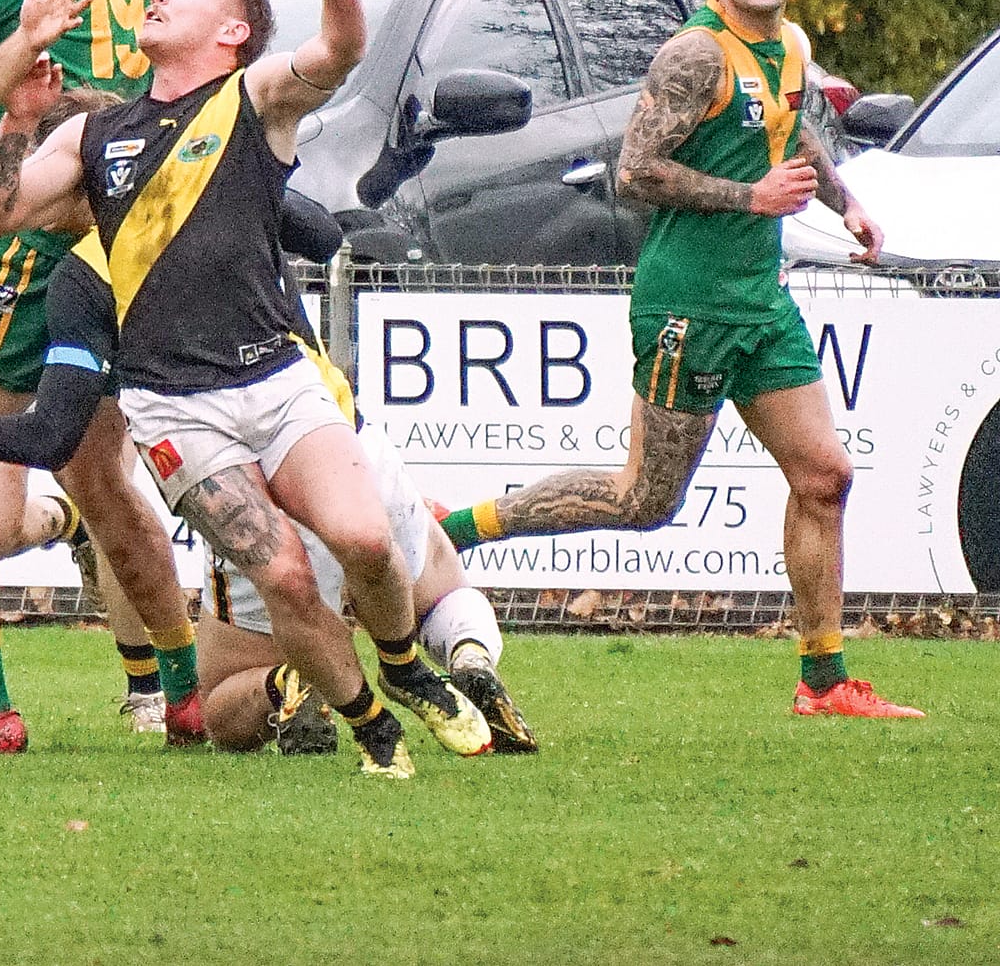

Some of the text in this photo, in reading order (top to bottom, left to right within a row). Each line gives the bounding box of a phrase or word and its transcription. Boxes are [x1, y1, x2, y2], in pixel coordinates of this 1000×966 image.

[383, 319, 592, 408] BRB
[384, 421, 546, 451] AWYERS
[560, 424, 580, 451] &
[918, 404, 961, 535] LAWYERS
[960, 382, 977, 398] &
